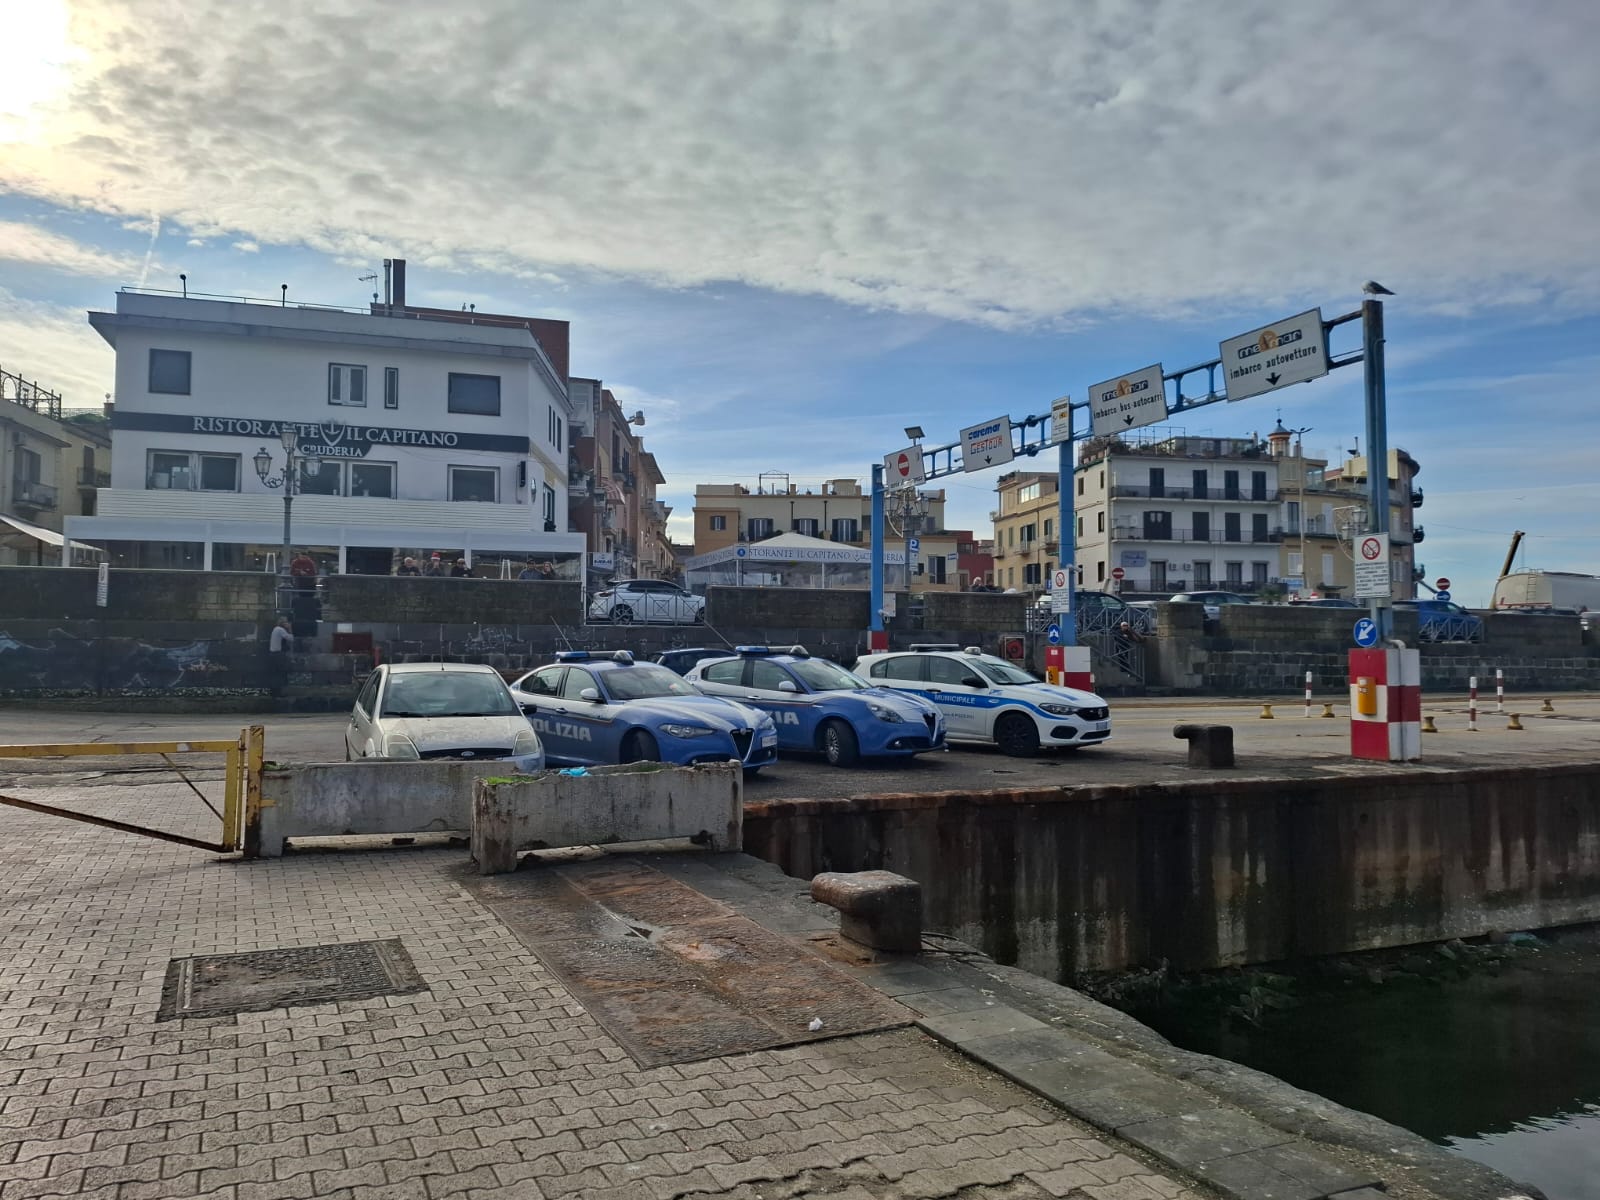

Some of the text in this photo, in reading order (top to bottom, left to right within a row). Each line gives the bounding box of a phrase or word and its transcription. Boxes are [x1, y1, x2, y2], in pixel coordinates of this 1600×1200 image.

[1230, 344, 1318, 380] imbarco autovetture
[1094, 406, 1117, 420] imbarco
[193, 416, 458, 446] RISTORATE IL CAPITANO
[807, 550, 850, 560] CAPITANO
[934, 694, 977, 705] MUNICIPALE
